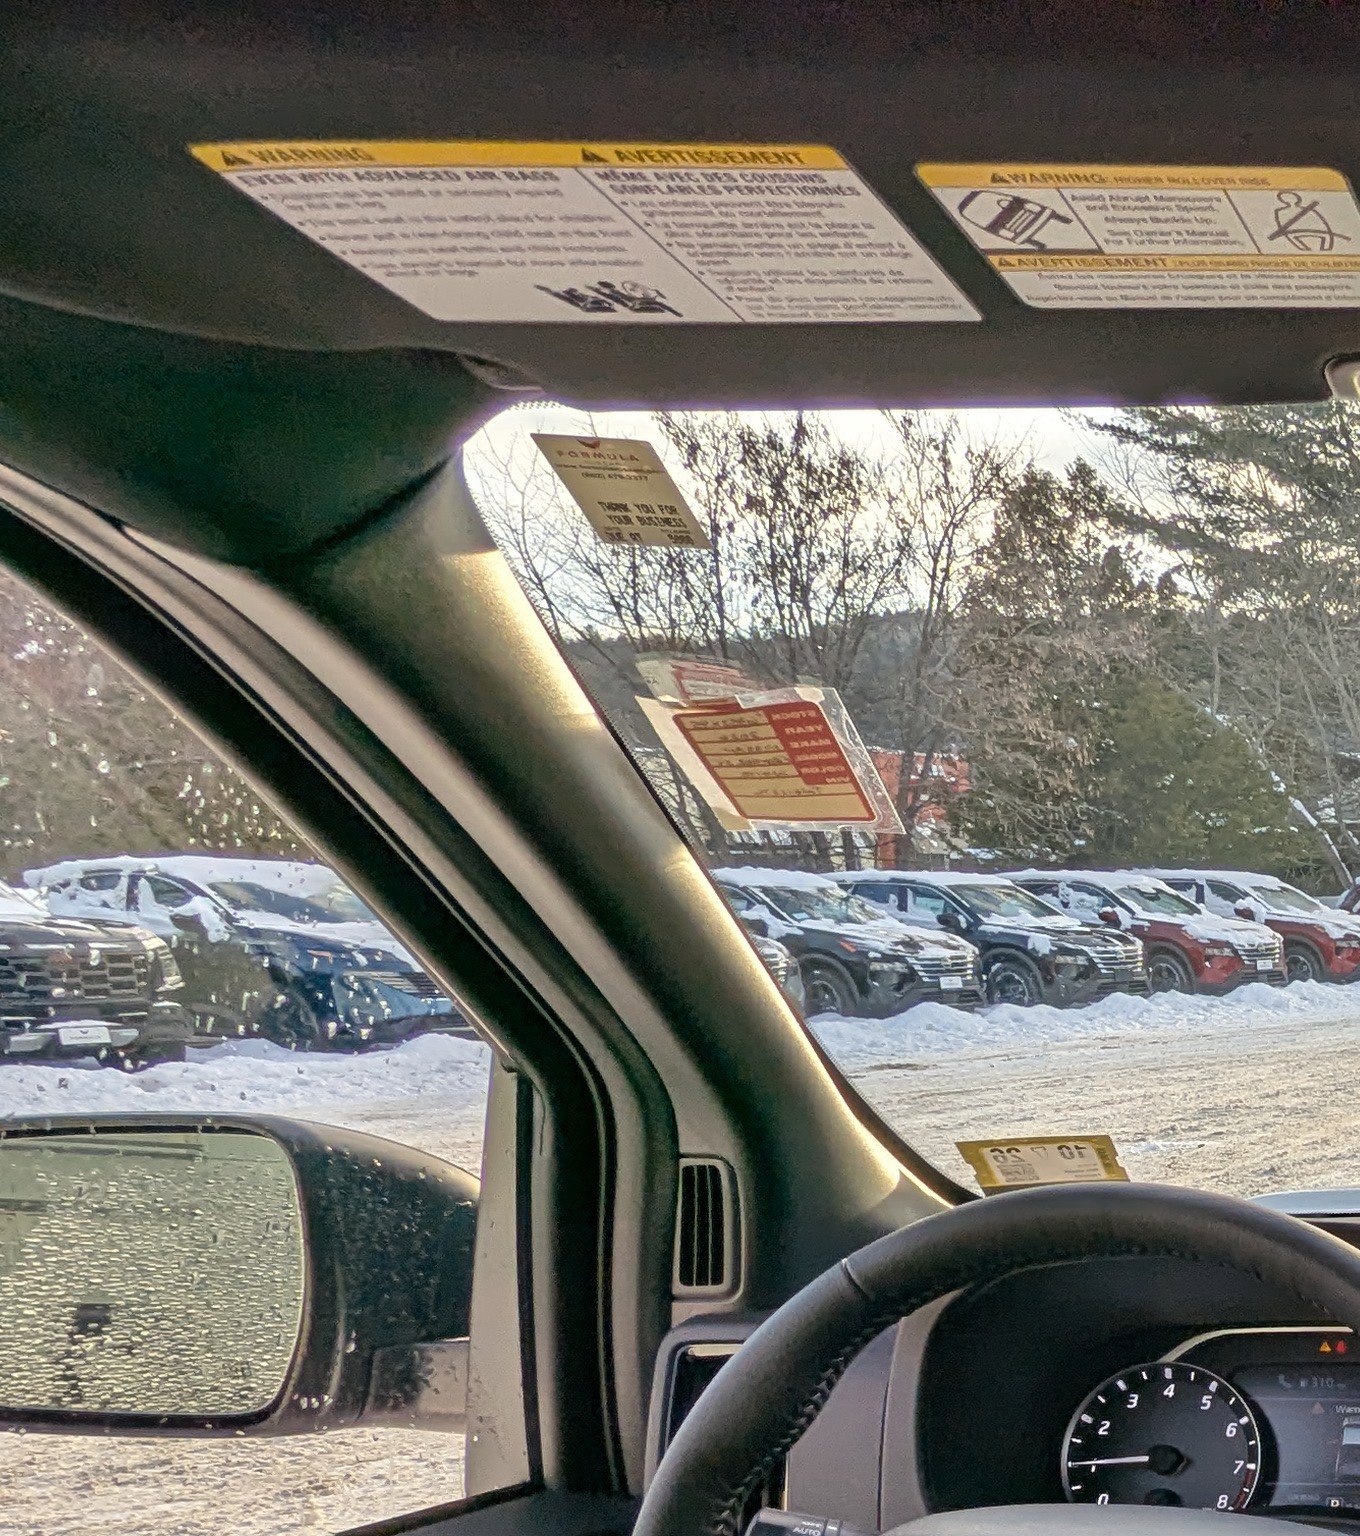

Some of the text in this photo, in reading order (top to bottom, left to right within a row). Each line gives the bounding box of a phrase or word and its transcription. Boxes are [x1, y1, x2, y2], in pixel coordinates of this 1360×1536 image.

[249, 147, 374, 164] WARNING
[614, 149, 806, 166] AVERTISSEMENT
[236, 169, 560, 188] EVEN WITH ADVANCED AIR BAGS
[556, 450, 640, 462] FORMULA
[633, 503, 656, 514] YOU
[656, 504, 681, 516] FOR
[605, 514, 634, 526] YOUR
[1163, 1383, 1176, 1398] 4
[1126, 1393, 1139, 1409] 3
[1200, 1395, 1213, 1411] 5
[1097, 1420, 1111, 1435] 2
[1225, 1422, 1238, 1438] 6
[1233, 1460, 1245, 1475] 7
[1097, 1493, 1109, 1506] 0
[1216, 1494, 1229, 1509] 8
